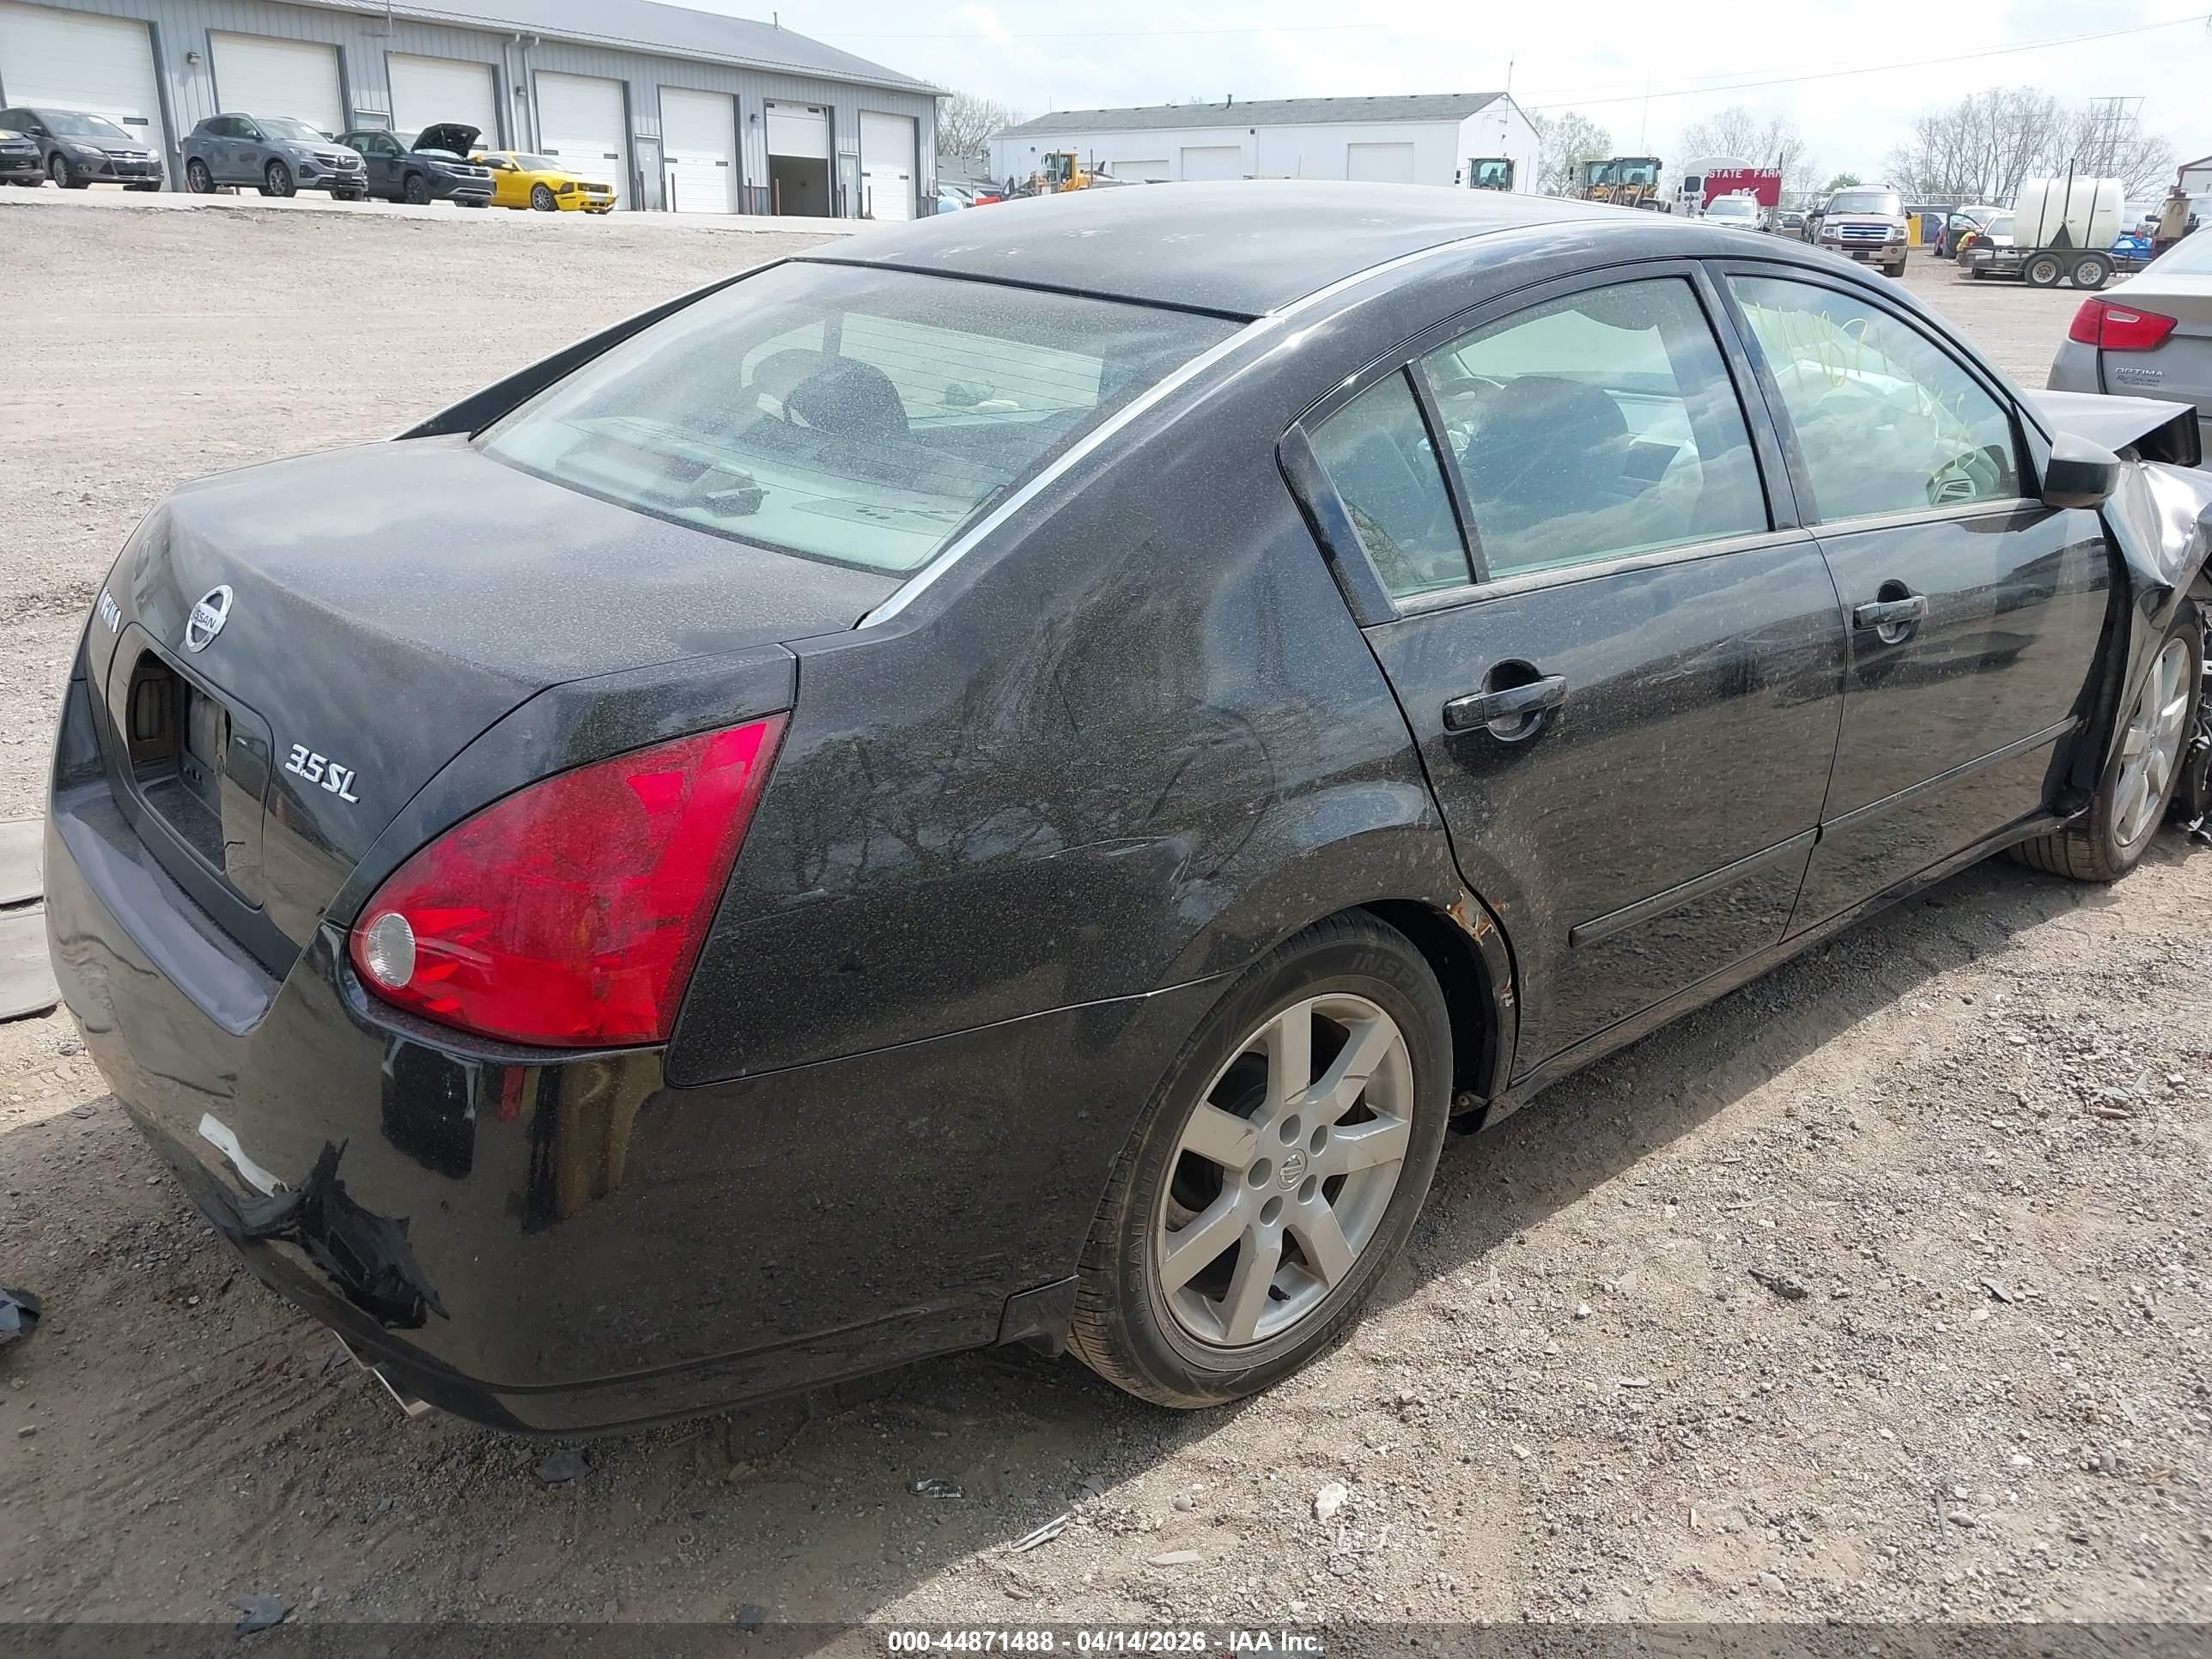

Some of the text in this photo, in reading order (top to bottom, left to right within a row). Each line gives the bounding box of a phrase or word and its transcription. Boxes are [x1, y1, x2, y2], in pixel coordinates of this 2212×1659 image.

[1709, 168, 1782, 179] STATE FARM
[2115, 367, 2163, 377] OPTIMA
